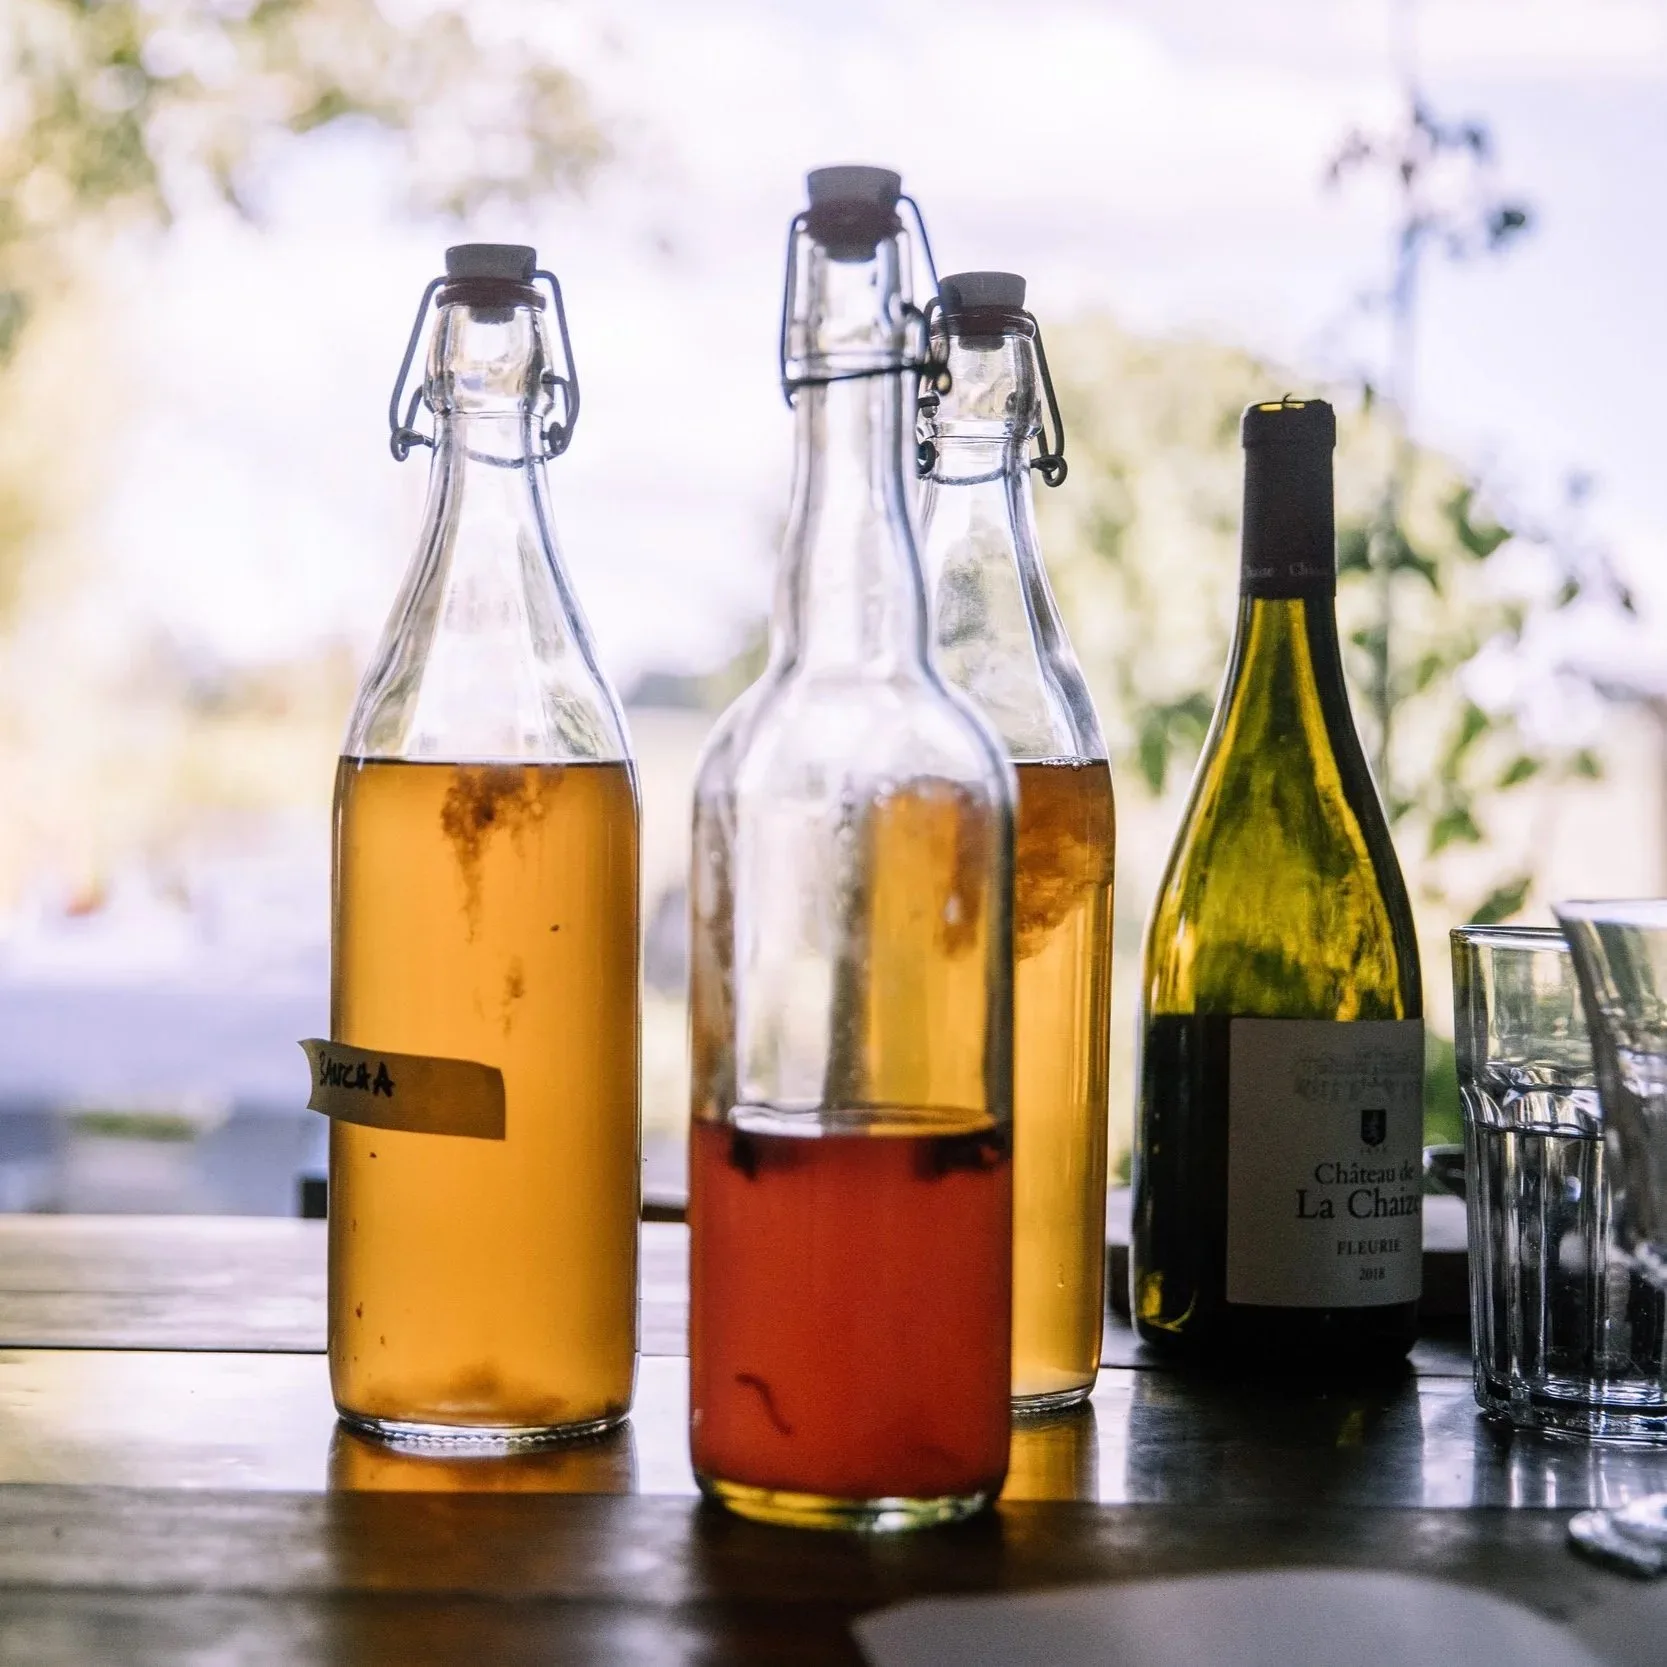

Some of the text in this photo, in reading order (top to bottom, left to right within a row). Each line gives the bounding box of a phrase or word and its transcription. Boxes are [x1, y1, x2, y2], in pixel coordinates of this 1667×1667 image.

[1314, 1159, 1414, 1184] Château de
[1295, 1189, 1335, 1219] La
[1336, 1238, 1401, 1256] FLEURIE
[1359, 1267, 1386, 1282] 2018
